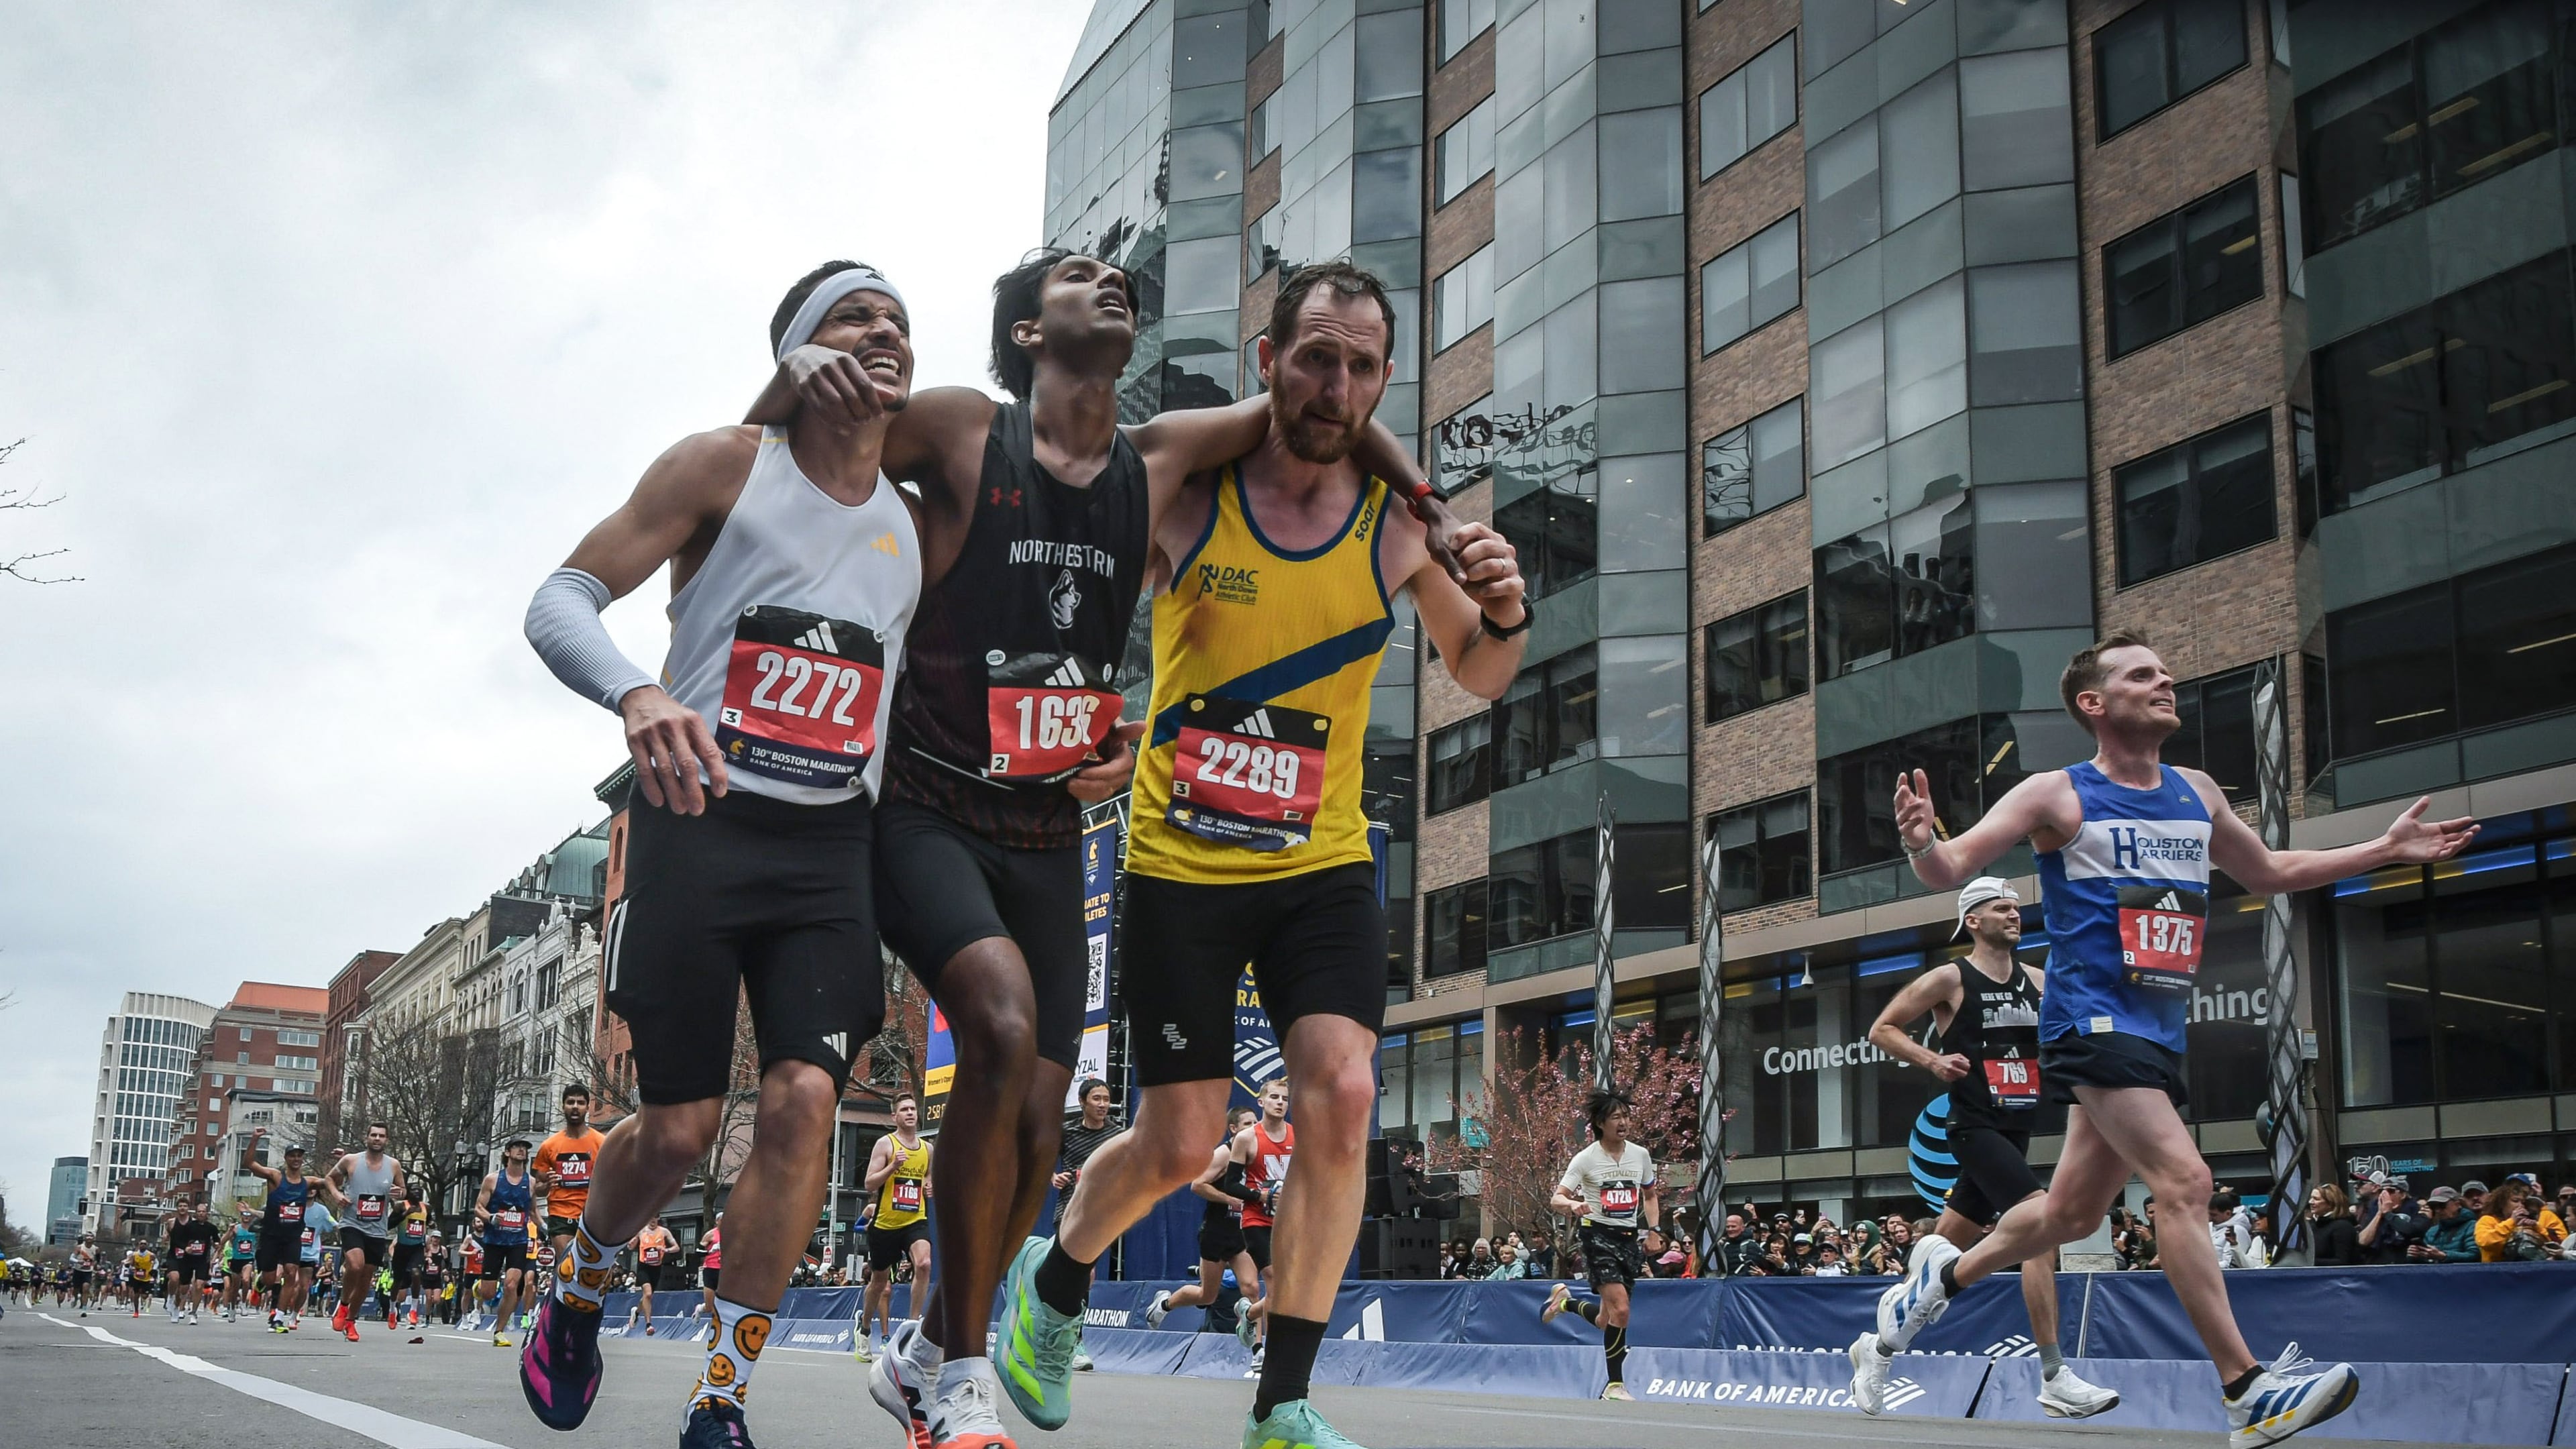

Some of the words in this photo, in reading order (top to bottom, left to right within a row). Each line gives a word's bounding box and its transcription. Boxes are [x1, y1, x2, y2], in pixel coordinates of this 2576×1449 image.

[1355, 500, 1375, 541] soar
[751, 651, 861, 727] 2272
[726, 711, 737, 722] 3
[749, 758, 769, 767] BANK
[782, 765, 813, 776] AMERICA
[771, 752, 808, 767] BOSTON
[809, 759, 855, 773] MARATHON
[994, 757, 1005, 770] 2
[1197, 737, 1300, 798] 2289
[1176, 783, 1186, 794] 3
[1197, 824, 1215, 832] BANK
[1217, 819, 1250, 832] BOSTON
[1251, 826, 1295, 838] MARATHO
[1100, 892, 1110, 904] TO
[2136, 914, 2194, 956] 1375
[2125, 953, 2133, 962] 2
[1240, 1016, 1256, 1026] OF
[1076, 1058, 1099, 1075] YZAL
[1996, 1062, 2028, 1084] 769
[562, 1160, 586, 1175] 3274
[2391, 1165, 2435, 1173] CONNECTING
[1607, 1189, 1633, 1204] 4728
[1646, 1379, 1712, 1399] BANK
[1714, 1382, 1743, 1401] OF
[1746, 1385, 1858, 1407] AMERICA
